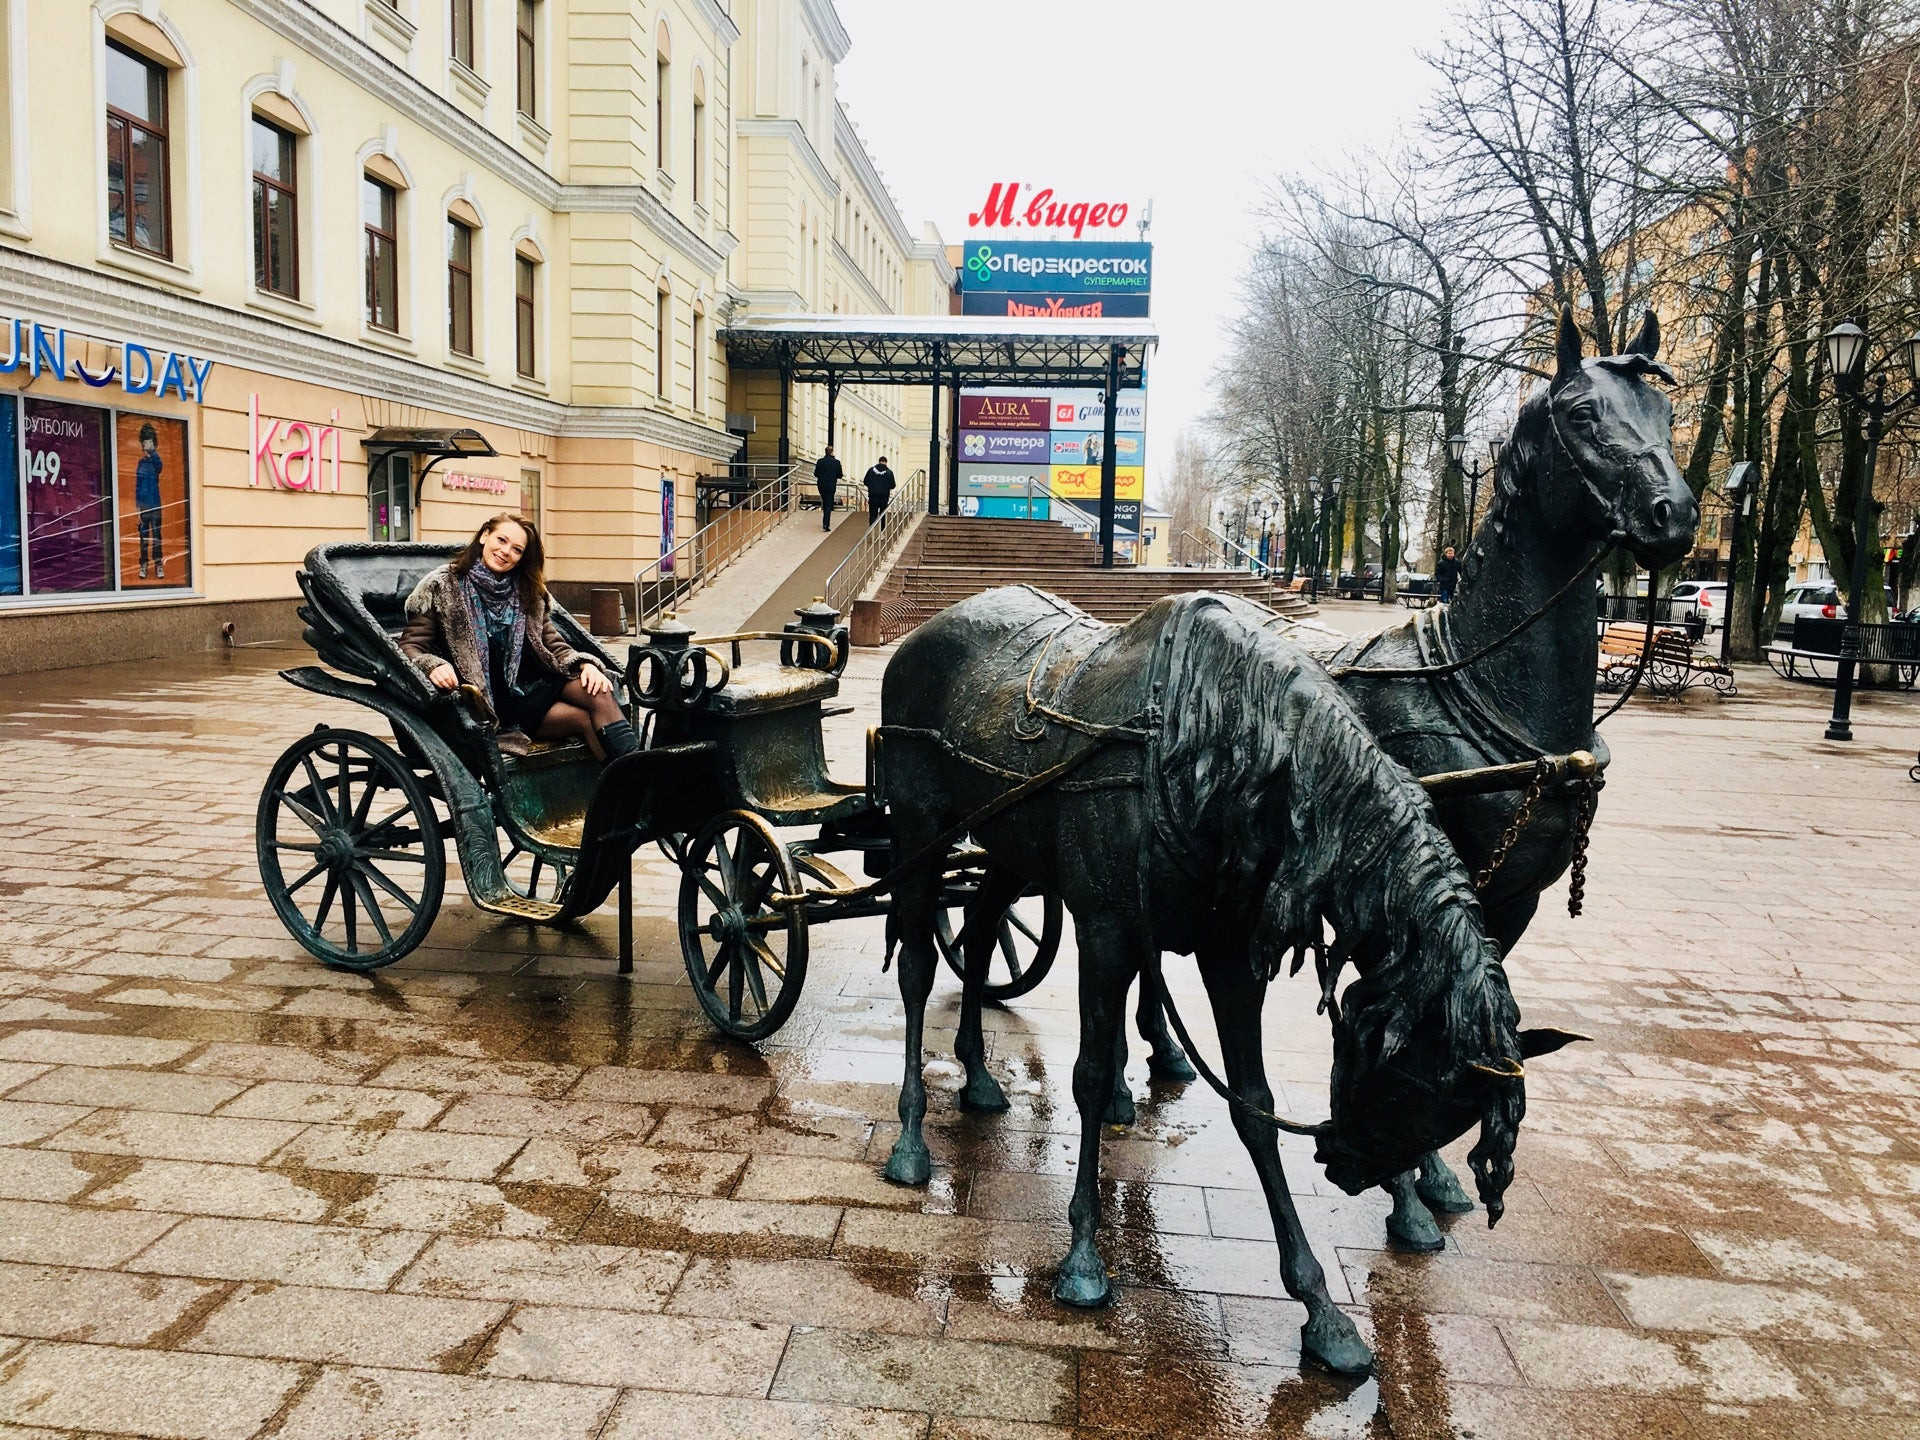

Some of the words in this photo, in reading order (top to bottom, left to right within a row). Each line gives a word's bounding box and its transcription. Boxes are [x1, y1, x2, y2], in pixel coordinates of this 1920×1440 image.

[968, 182, 1128, 239] М.видео
[1003, 253, 1148, 279] Перекресток
[1083, 277, 1148, 287] СУПЕРМАРКЕТ
[122, 342, 213, 404] DAY
[978, 397, 1030, 416] AURA
[1058, 407, 1073, 419] GJ
[1079, 406, 1105, 421] GLOR
[24, 415, 84, 438] ФУТБОЛКИ
[248, 392, 341, 492] kari
[988, 436, 1045, 450] уютерра
[1114, 504, 1138, 513] NGO
